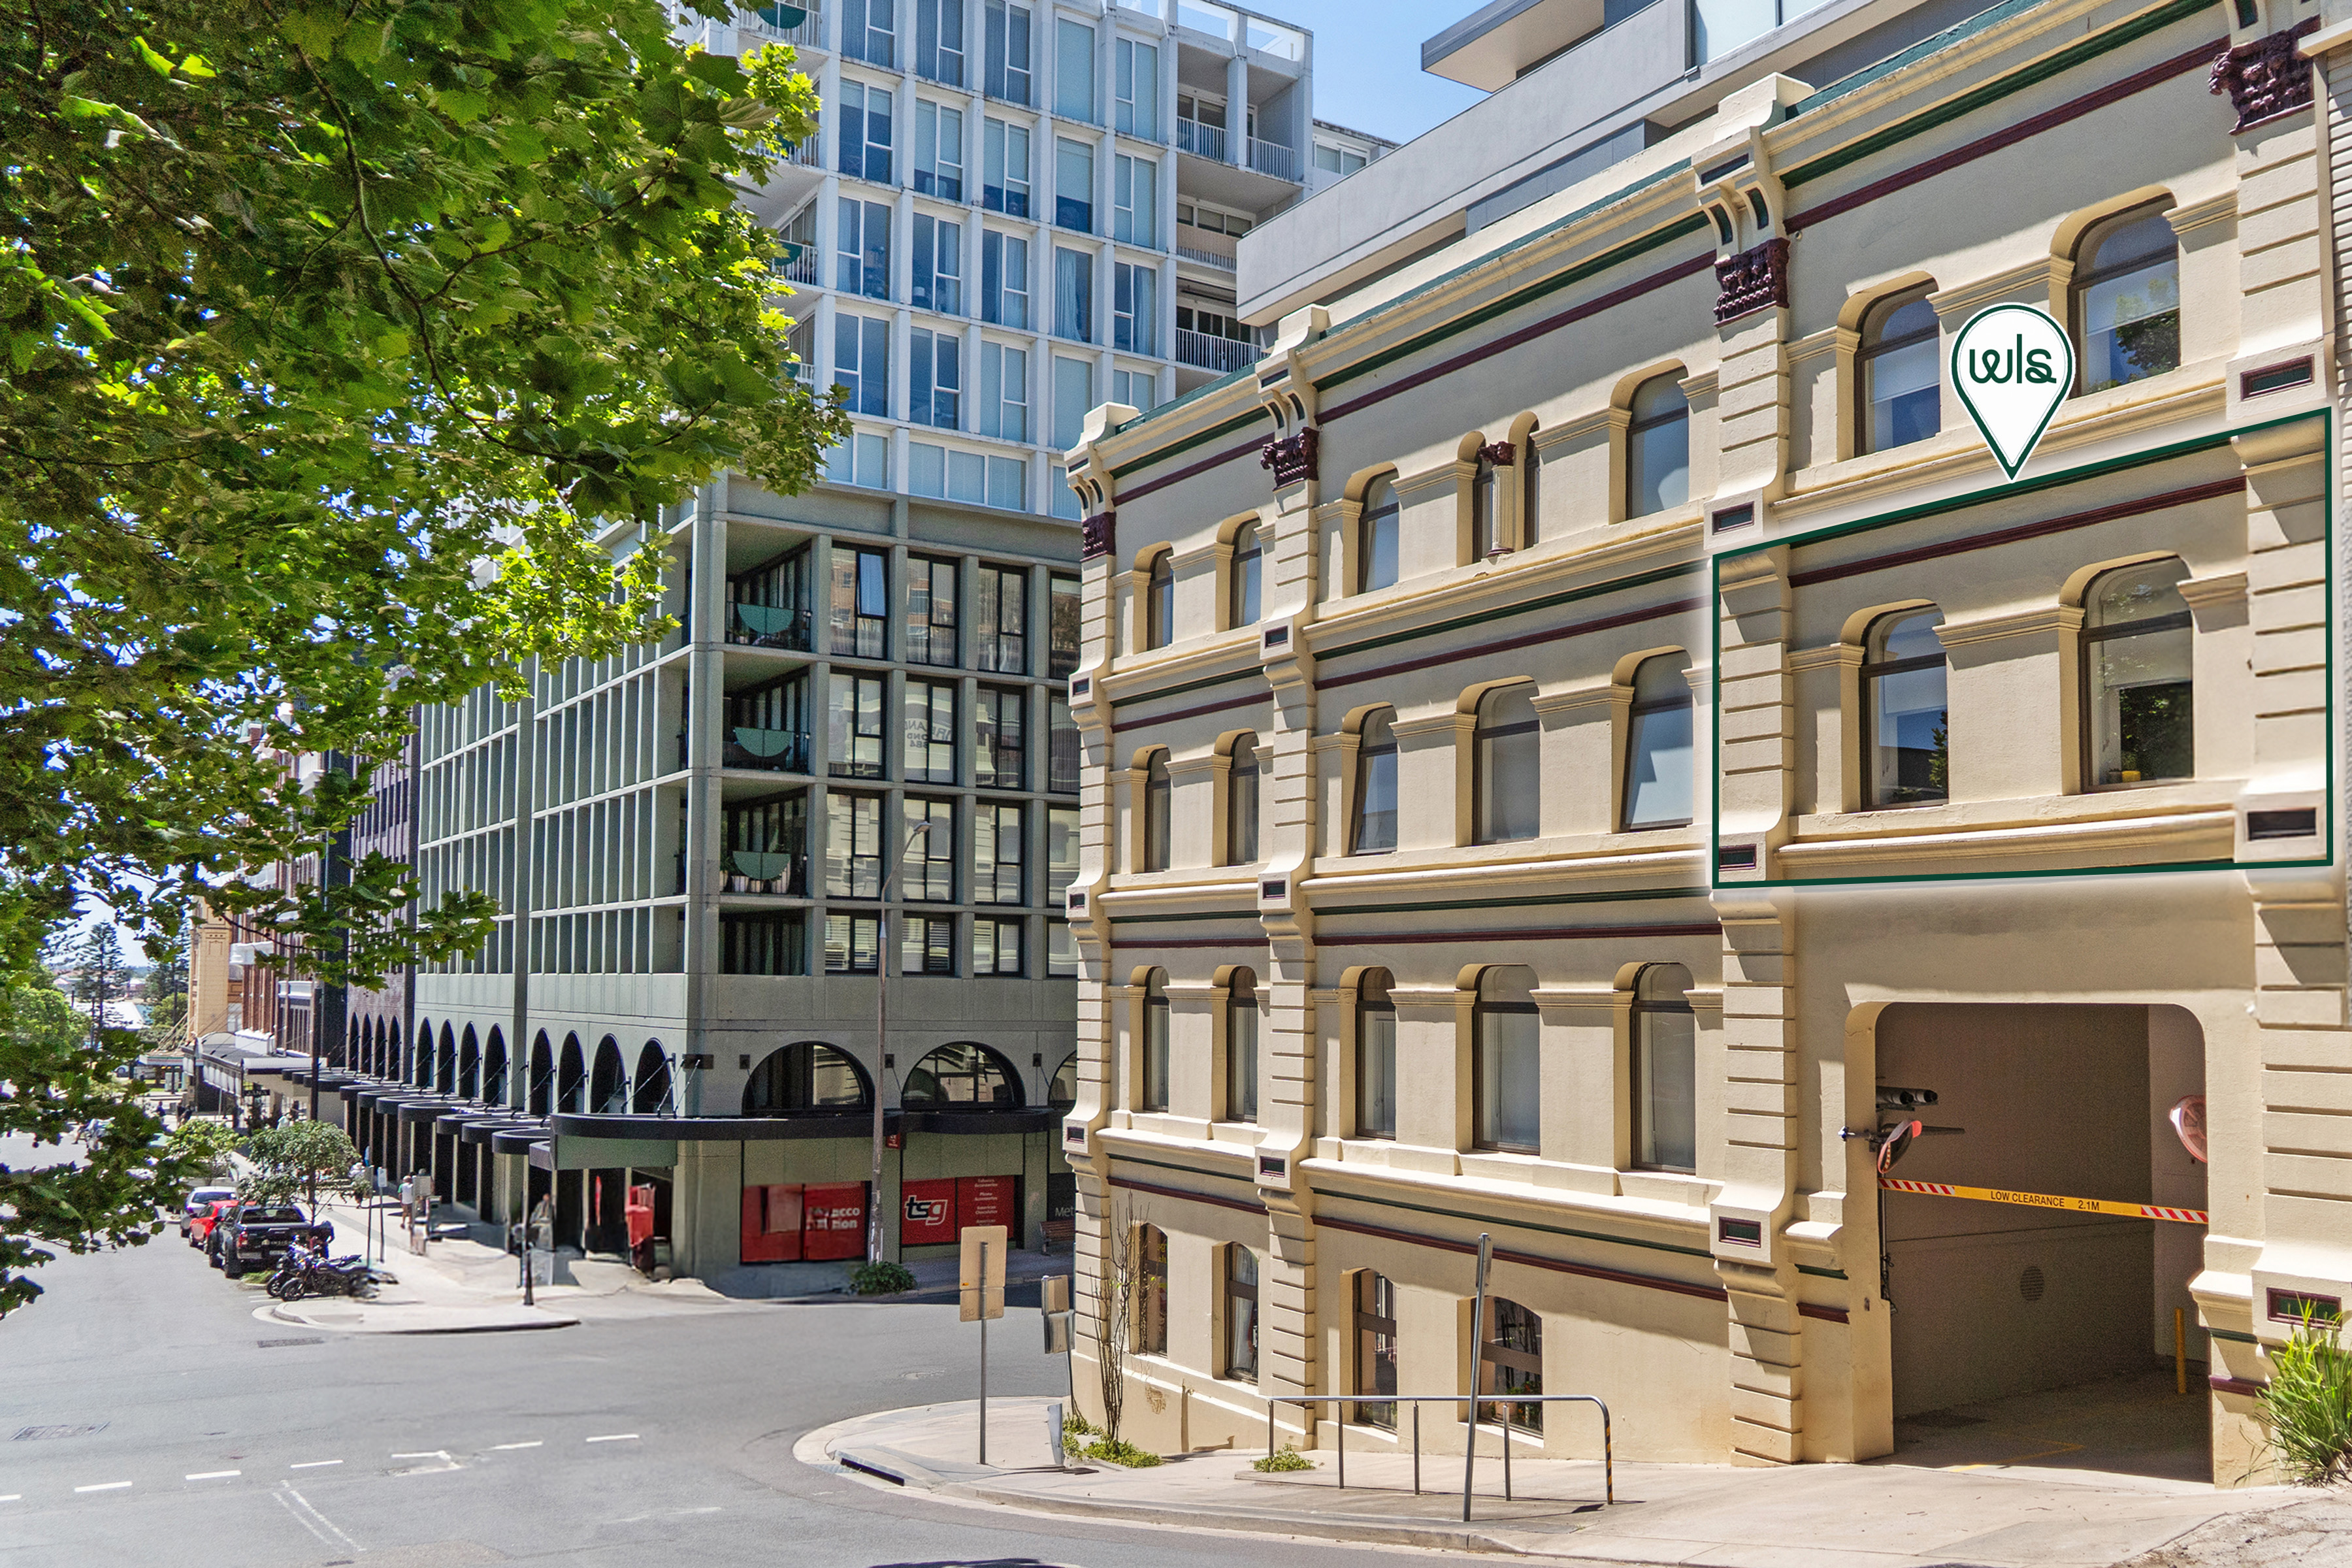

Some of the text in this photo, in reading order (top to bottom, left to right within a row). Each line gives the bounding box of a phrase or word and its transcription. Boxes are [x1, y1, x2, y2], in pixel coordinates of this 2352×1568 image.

[905, 1195, 948, 1226] tsg
[1991, 1191, 2099, 1211] LOW CLEARANCE 2.1M
